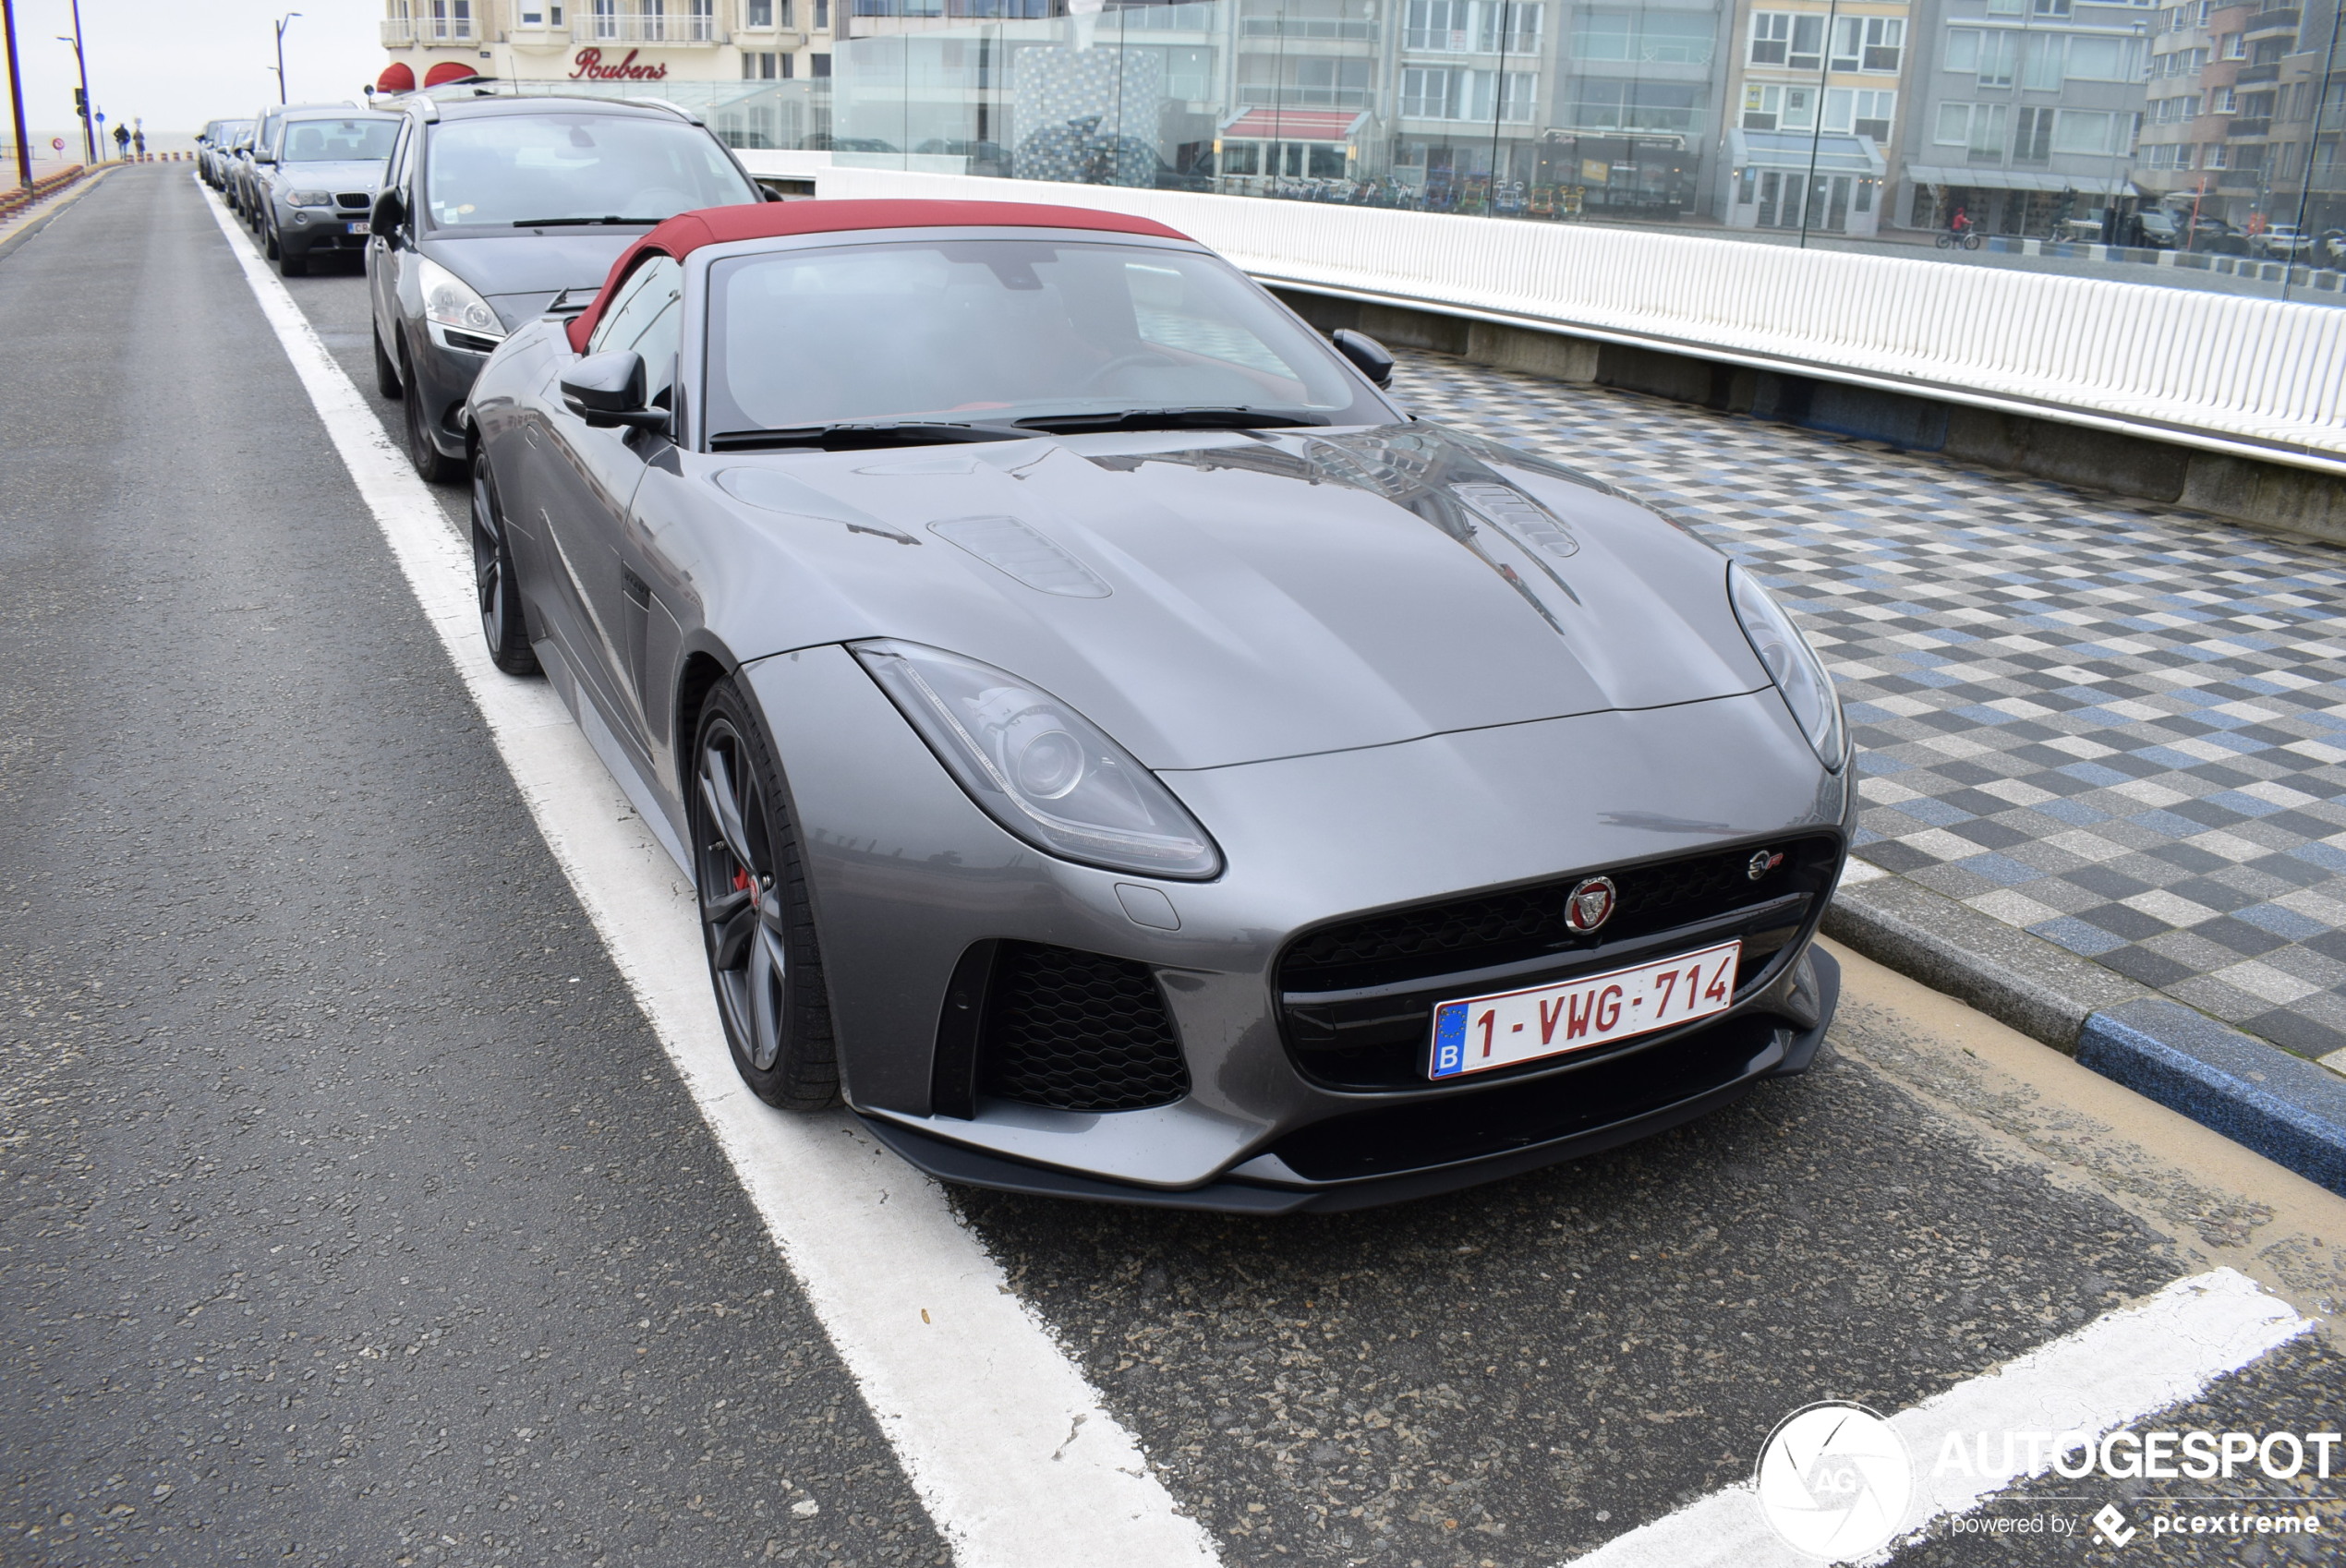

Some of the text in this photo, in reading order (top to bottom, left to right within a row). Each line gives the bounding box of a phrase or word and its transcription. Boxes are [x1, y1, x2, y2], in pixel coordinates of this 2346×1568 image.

[569, 47, 668, 79] Rubens
[1477, 956, 1732, 1058] 1-VWG-714
[1439, 1044, 1458, 1069] B
